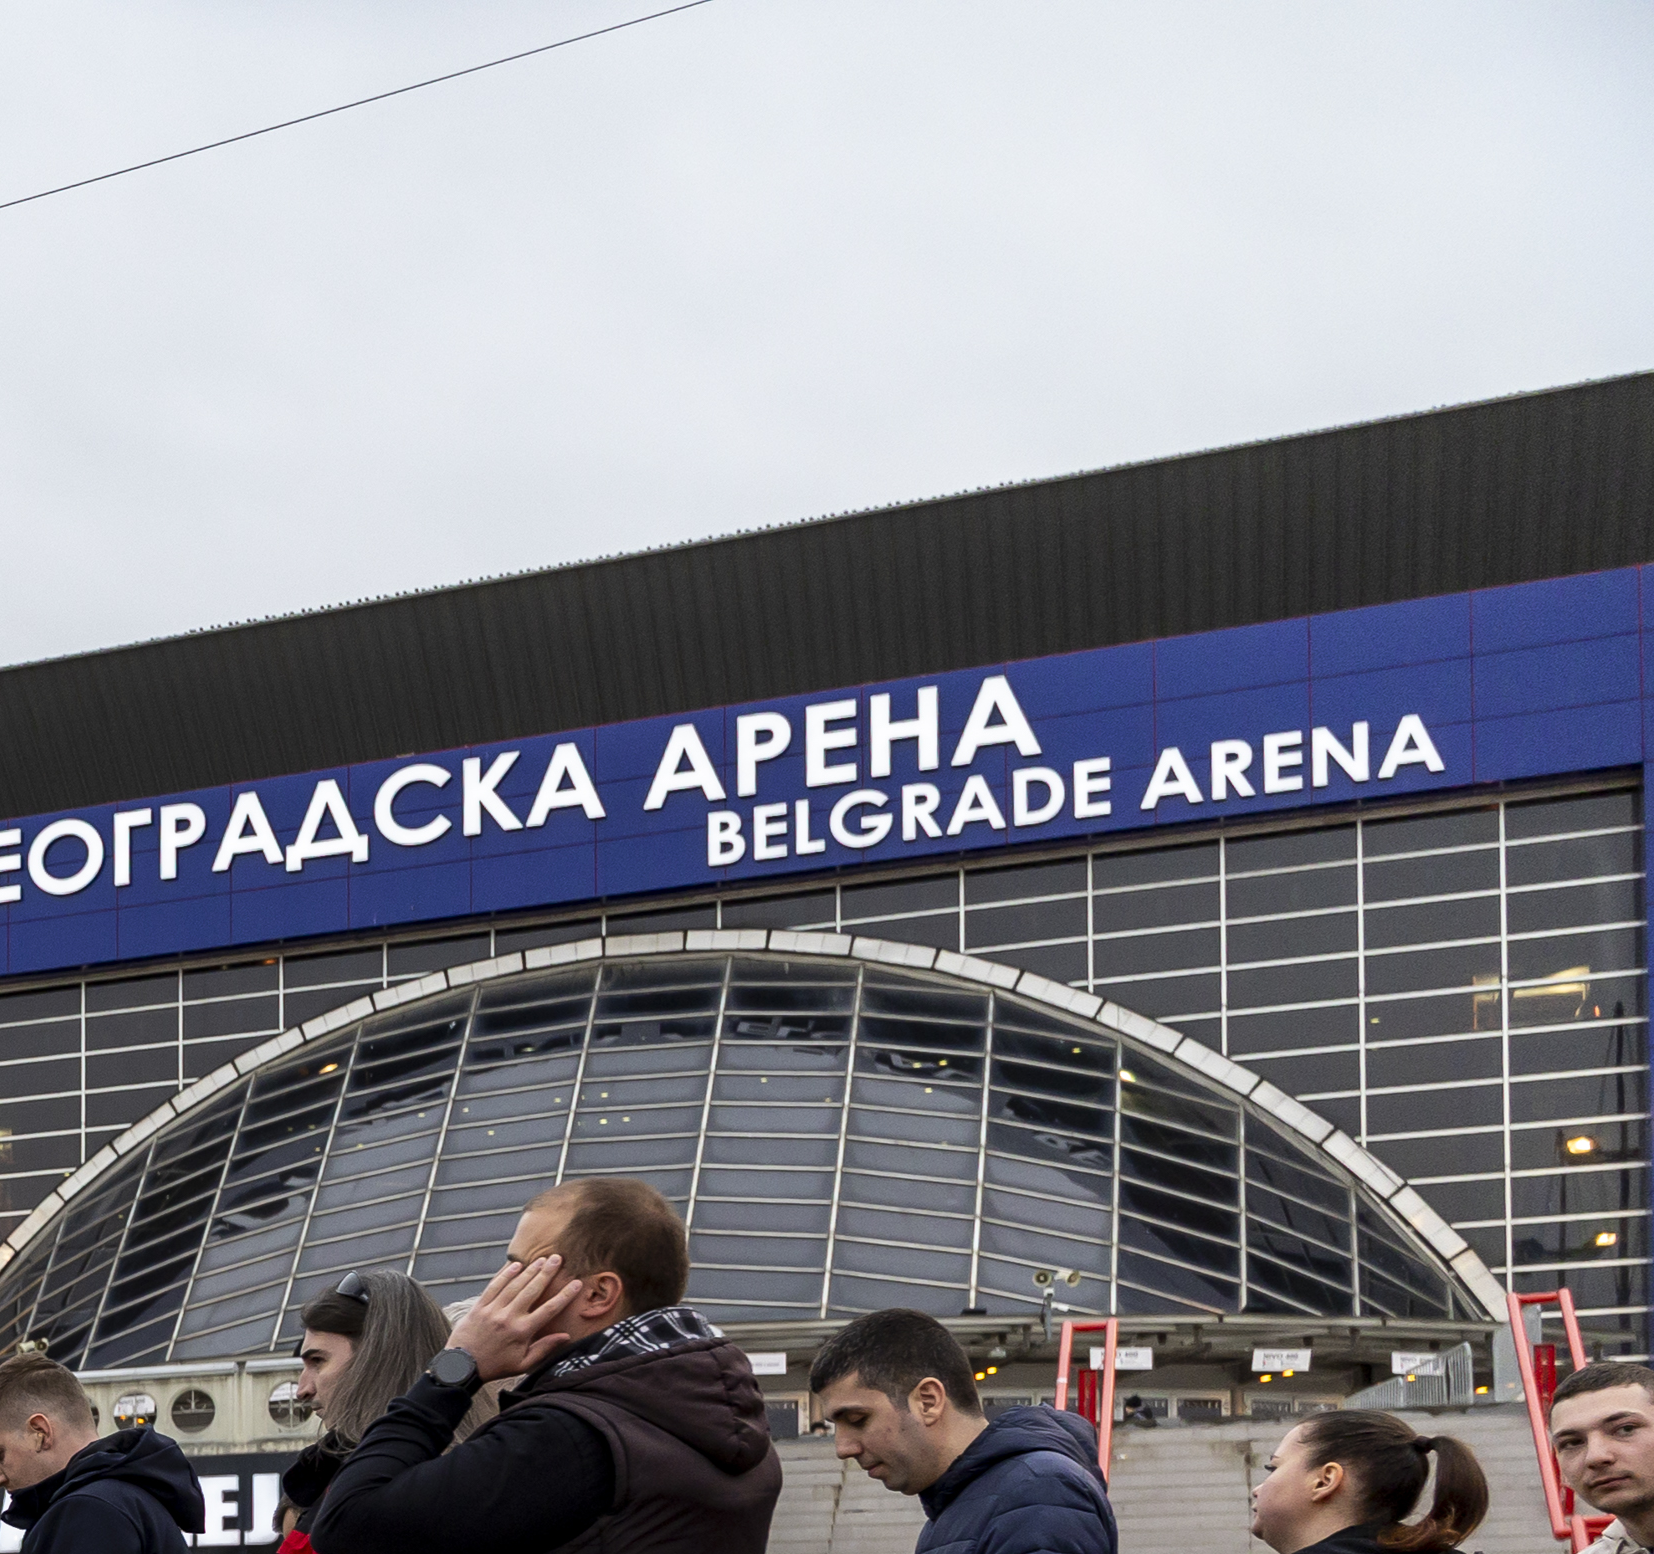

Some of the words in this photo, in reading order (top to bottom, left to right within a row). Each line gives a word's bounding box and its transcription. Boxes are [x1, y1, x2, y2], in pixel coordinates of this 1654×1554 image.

[644, 674, 1042, 813] АРЕНА
[707, 757, 1113, 867] BELGRADE
[1140, 713, 1447, 811] ARENA
